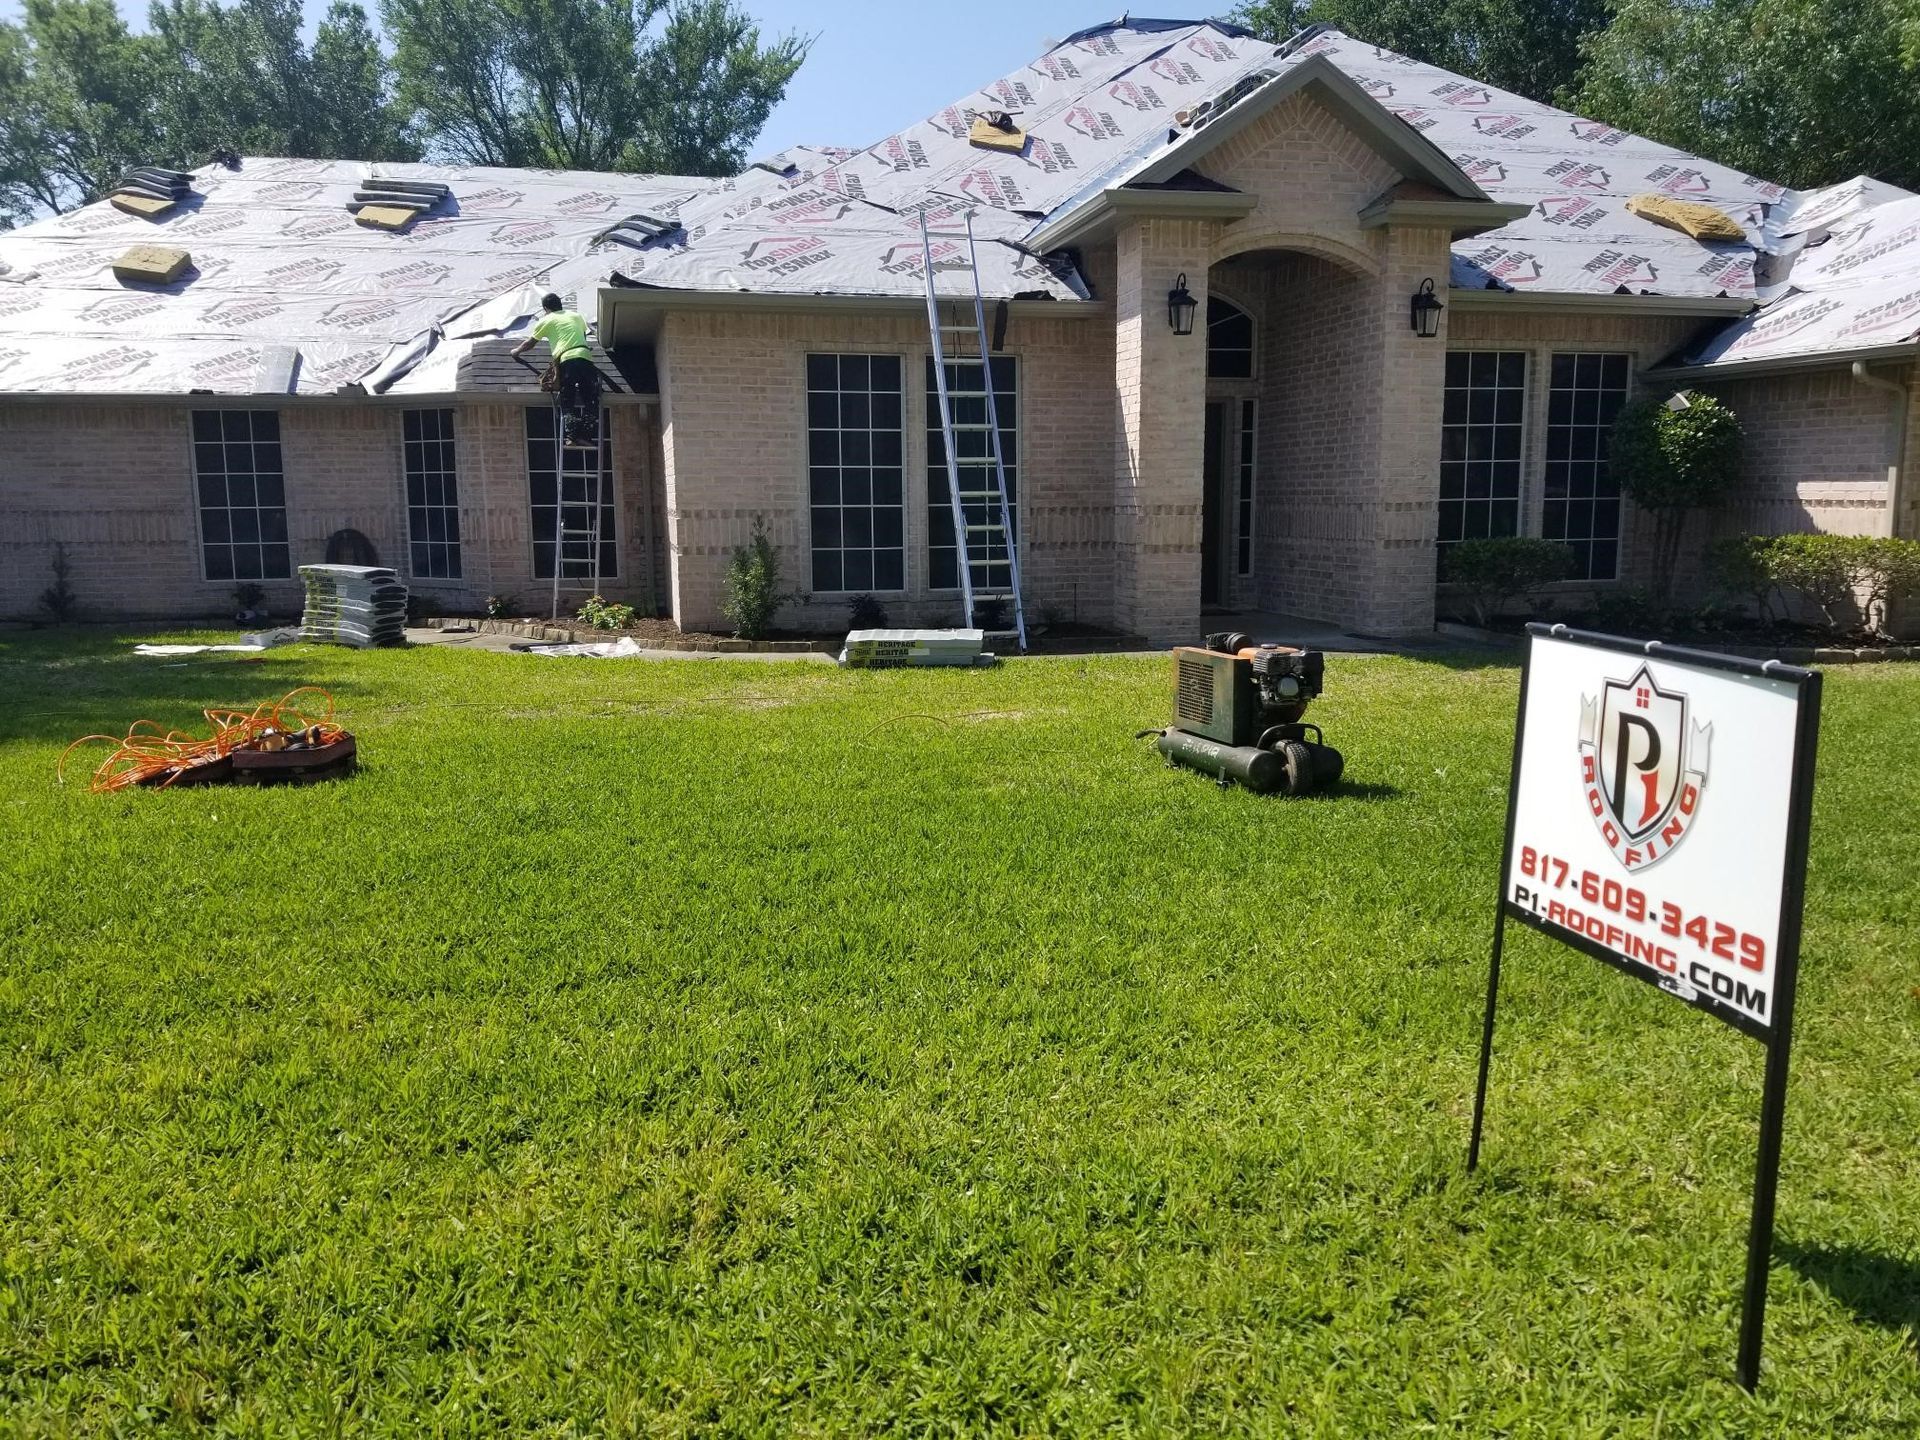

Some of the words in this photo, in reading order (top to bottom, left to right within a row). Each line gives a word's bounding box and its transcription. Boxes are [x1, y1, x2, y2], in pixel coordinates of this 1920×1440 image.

[738, 236, 827, 271] TopShield
[768, 249, 836, 277] TSMax
[1583, 755, 1697, 867] ROOFING
